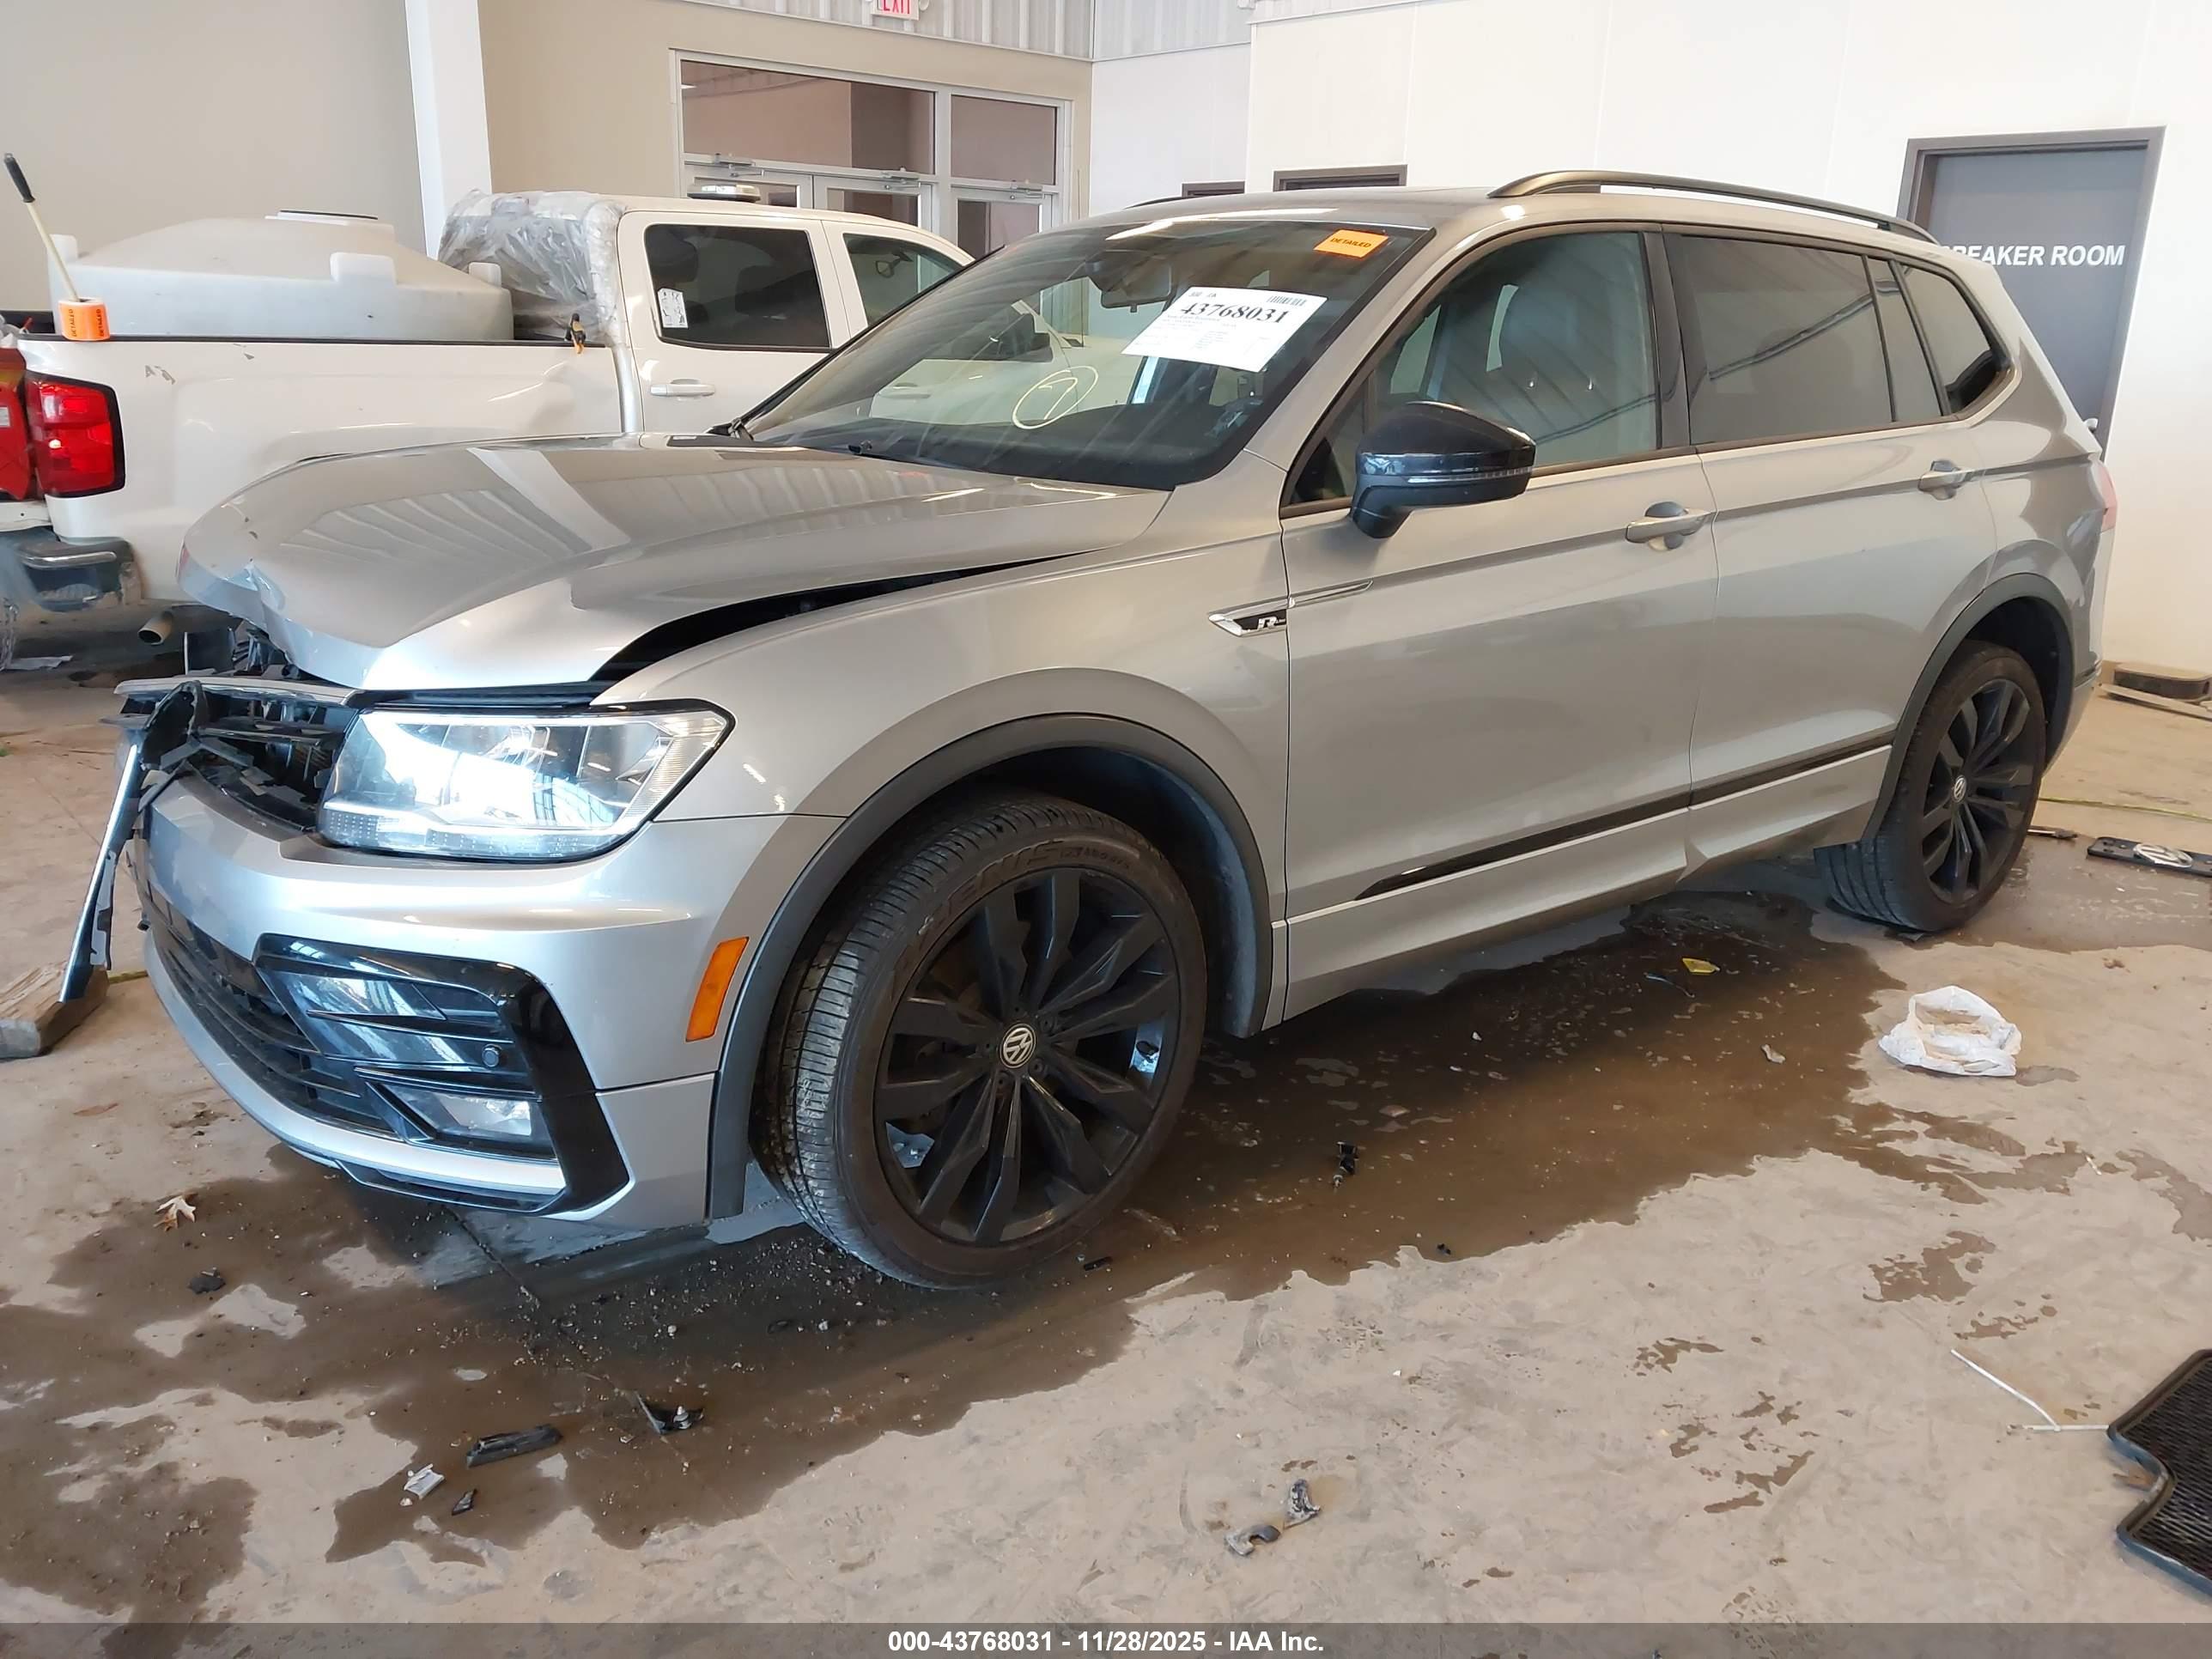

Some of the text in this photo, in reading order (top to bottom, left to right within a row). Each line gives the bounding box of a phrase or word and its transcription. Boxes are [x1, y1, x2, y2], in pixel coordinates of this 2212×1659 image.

[1330, 237, 1371, 248] DETAILED
[1942, 245, 2125, 265] EAKER ROOM
[1181, 302, 1290, 324] 43768031
